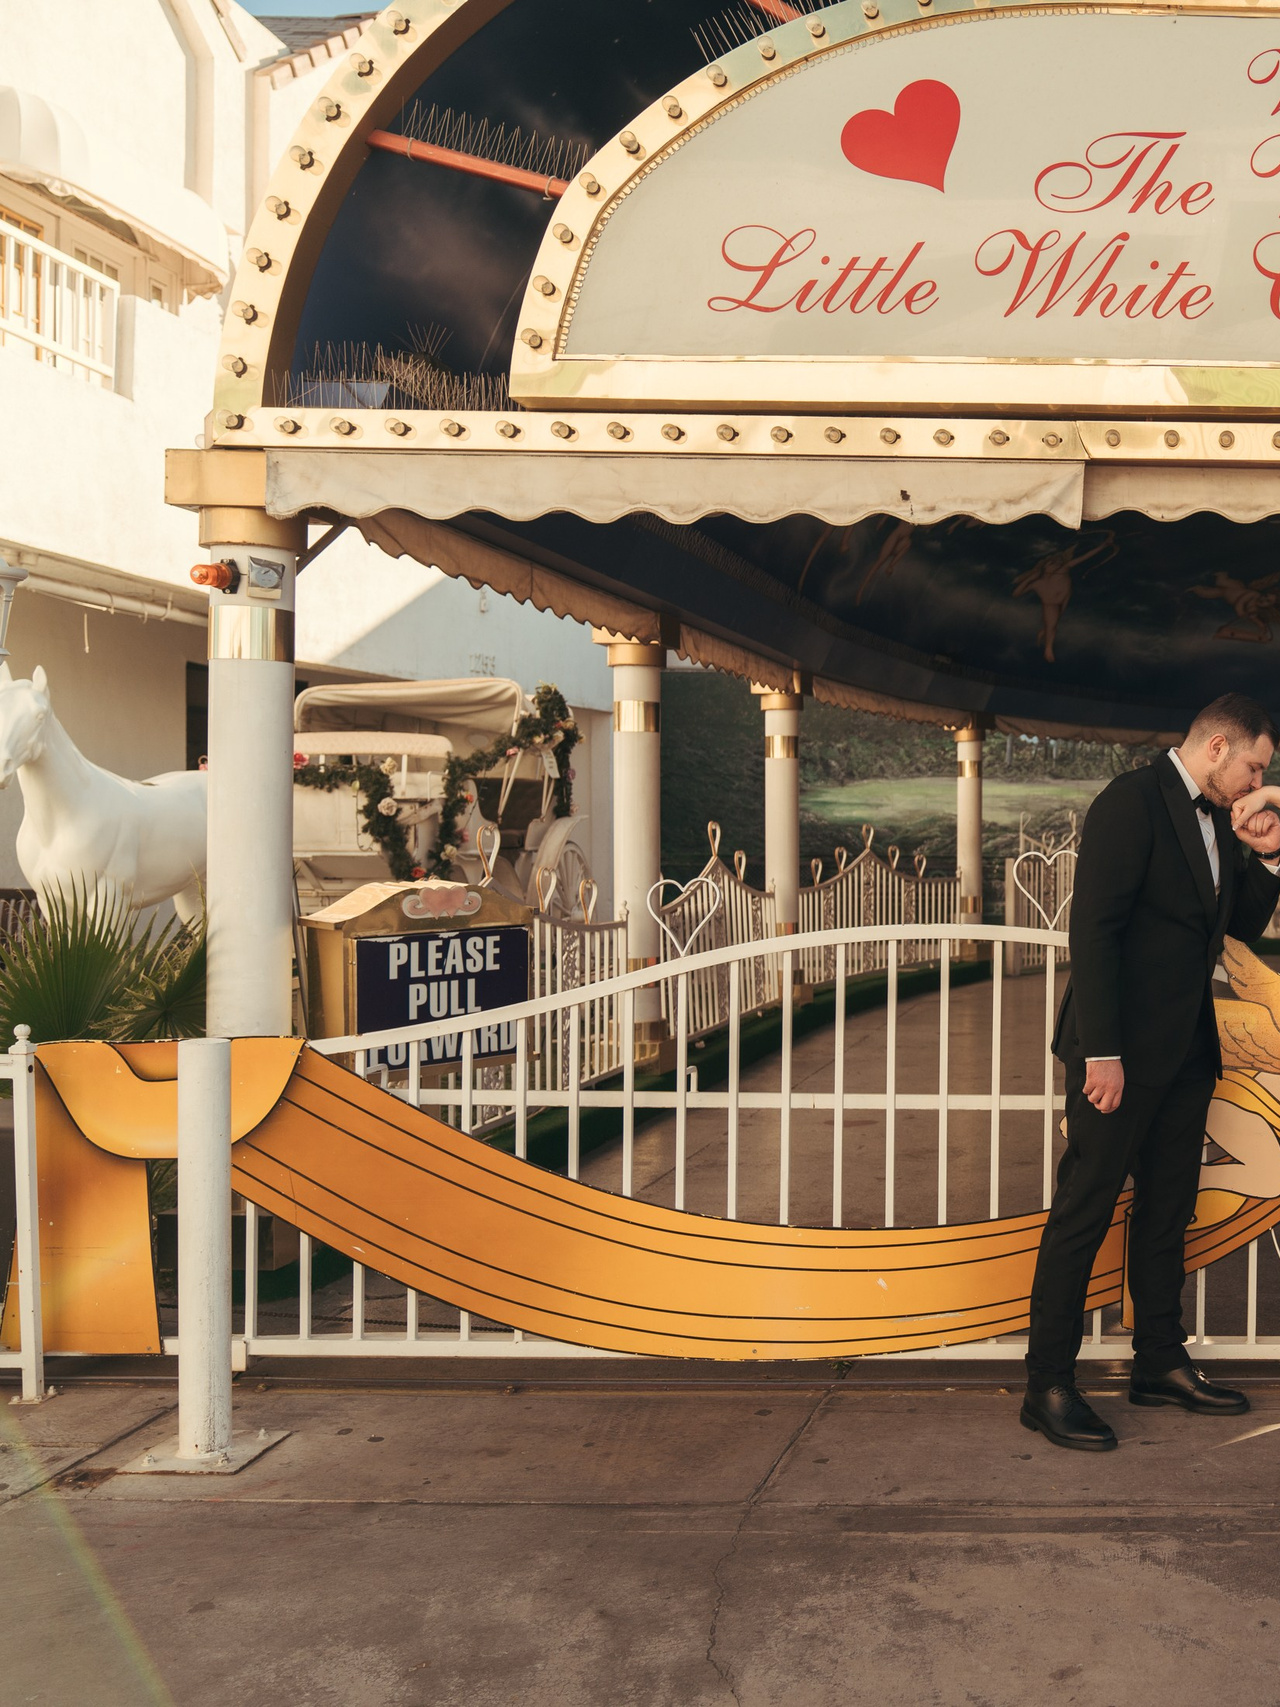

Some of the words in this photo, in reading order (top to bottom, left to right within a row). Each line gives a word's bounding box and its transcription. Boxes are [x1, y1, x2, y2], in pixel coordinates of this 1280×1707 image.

[1034, 131, 1216, 215] The
[707, 224, 940, 316] Little
[974, 228, 1215, 320] White
[388, 935, 500, 980] PLEASE
[408, 978, 482, 1021] PULL
